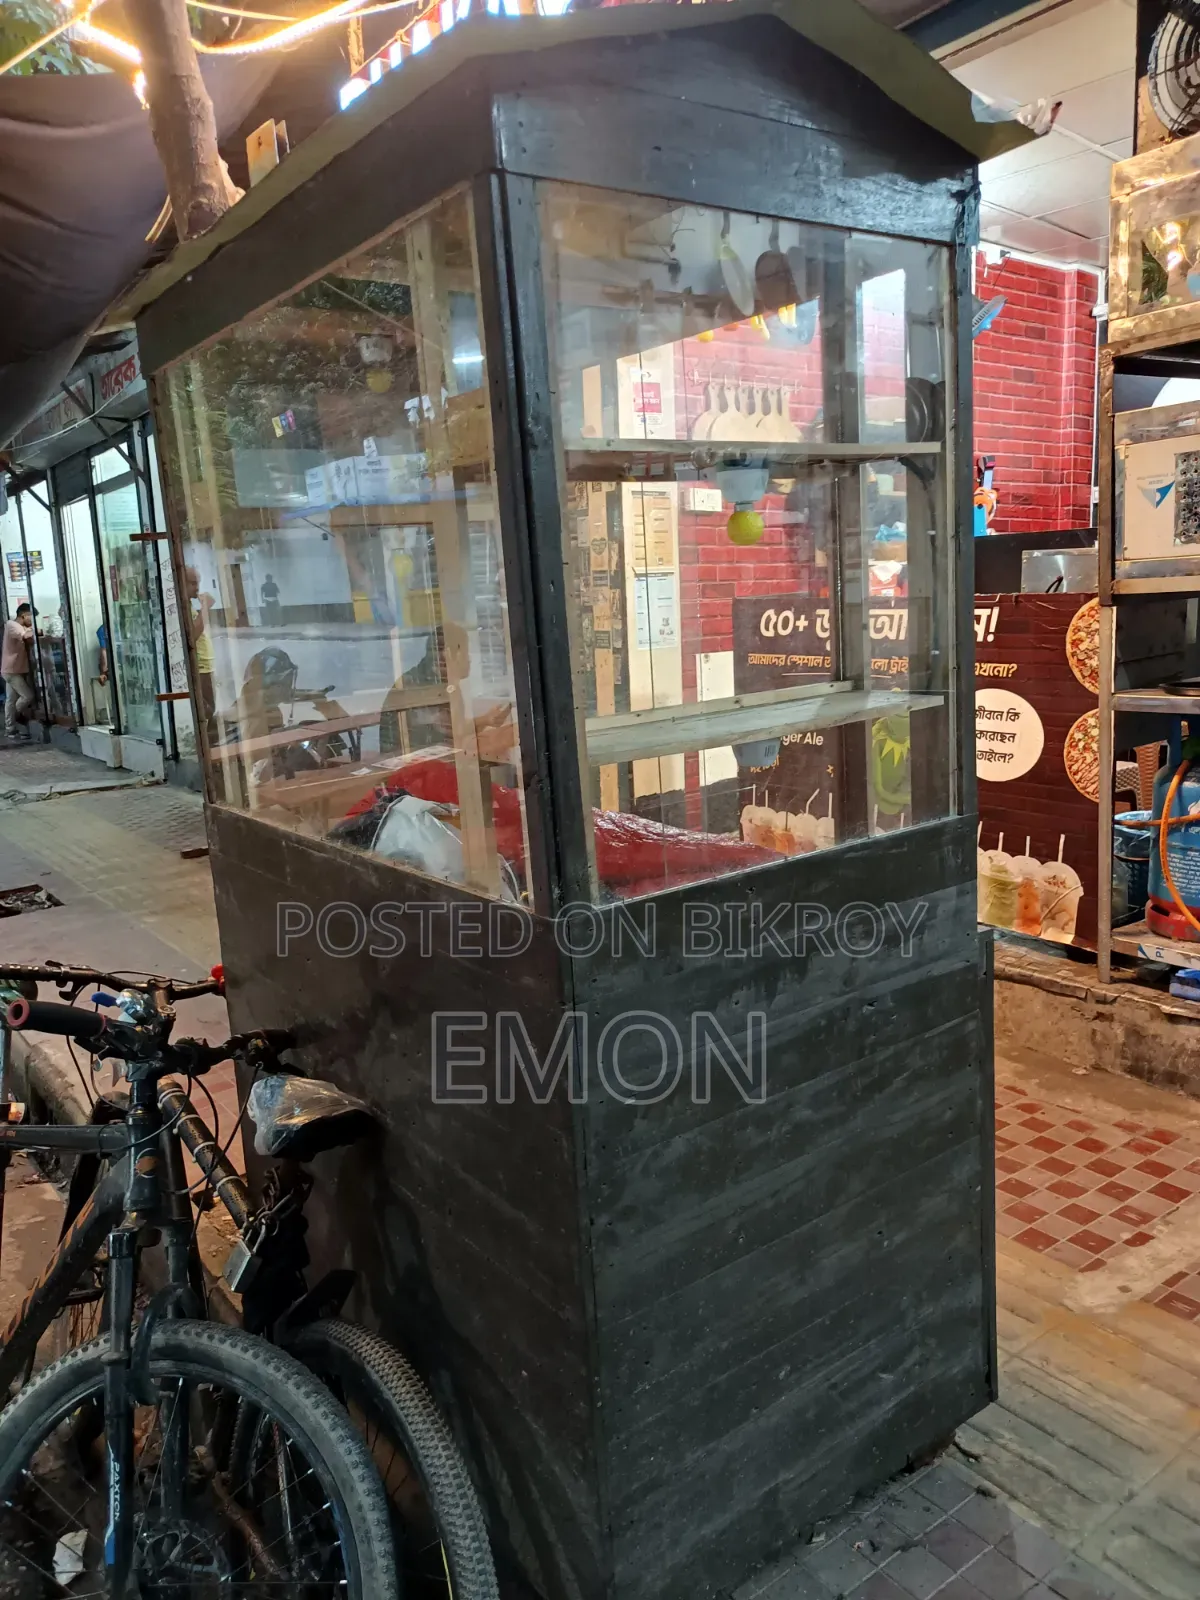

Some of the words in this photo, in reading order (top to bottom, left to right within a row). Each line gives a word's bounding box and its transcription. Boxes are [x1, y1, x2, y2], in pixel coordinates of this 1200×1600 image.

[760, 608, 808, 637] ৫০+
[869, 609, 908, 640] আ
[748, 653, 786, 667] আমাদের
[871, 658, 887, 671] লো
[1005, 708, 1021, 722] কি
[781, 733, 803, 746] ger
[804, 732, 824, 746] Ale
[976, 730, 1016, 743] করেছেন
[977, 748, 1014, 763] তাইলে?
